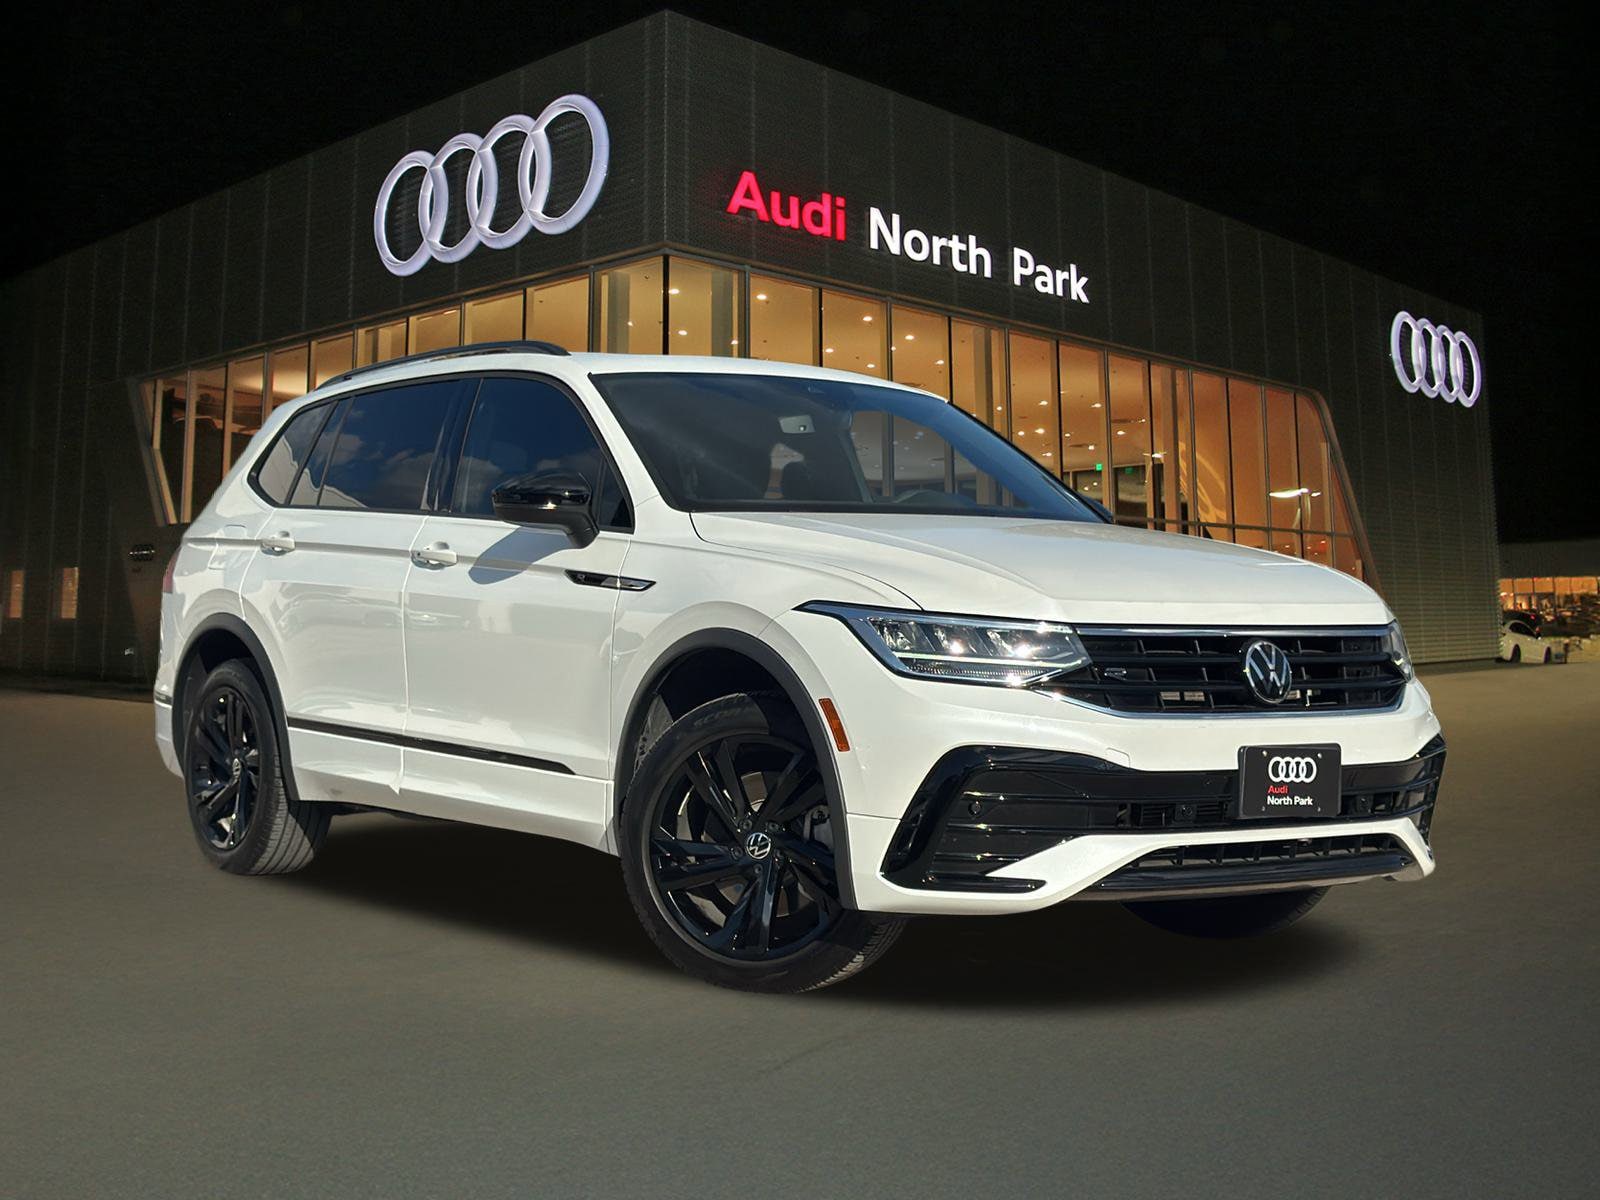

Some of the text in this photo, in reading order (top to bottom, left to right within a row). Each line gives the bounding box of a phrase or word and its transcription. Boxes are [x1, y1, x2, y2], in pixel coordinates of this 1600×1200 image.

[726, 170, 1090, 304] Audi North Park
[1268, 785, 1288, 794] Audi
[1267, 795, 1313, 806] North Park
